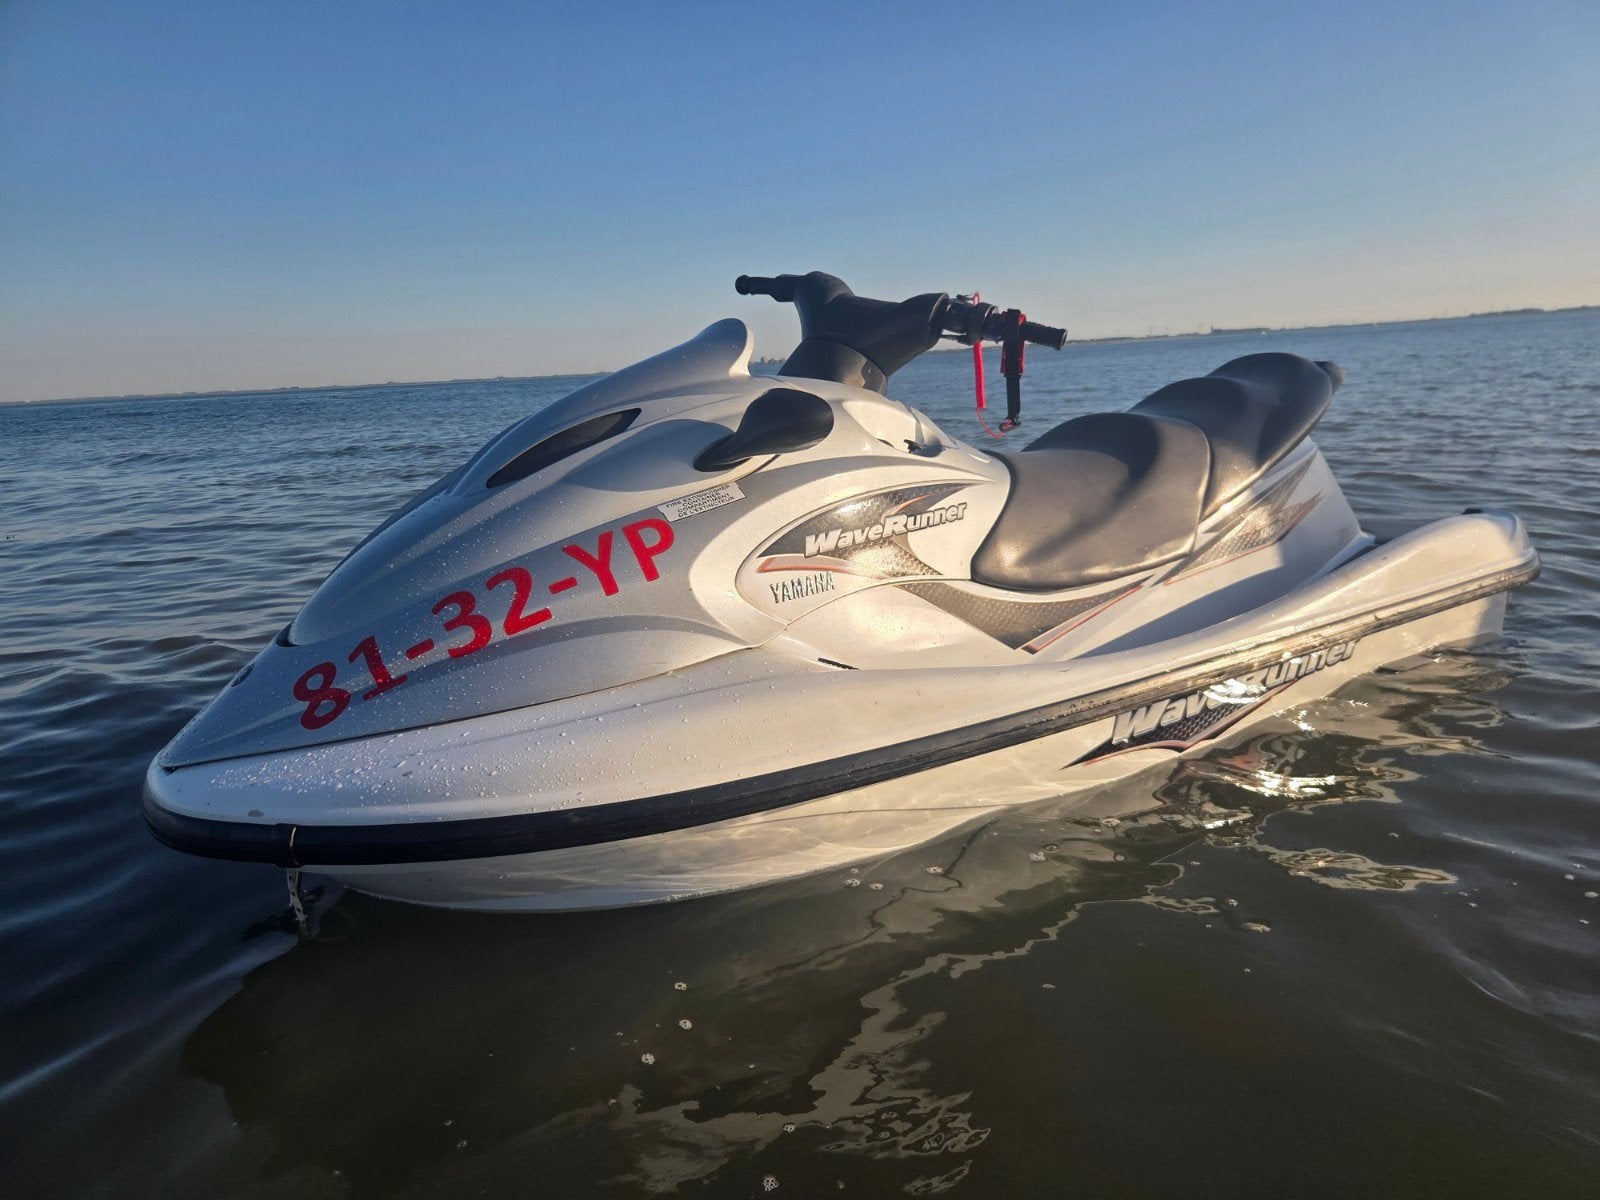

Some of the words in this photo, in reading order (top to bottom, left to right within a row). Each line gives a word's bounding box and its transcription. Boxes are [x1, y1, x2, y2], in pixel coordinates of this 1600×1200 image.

[666, 498, 683, 508] FIRE
[683, 484, 731, 503] EXTINGUISHER
[677, 493, 730, 513] COMPARTIMENT
[682, 492, 721, 507] CONTAINER
[678, 509, 688, 518] DE
[804, 502, 967, 558] WaveRunner
[770, 571, 836, 604] YAMAHA
[293, 518, 675, 730] 81-32-YP
